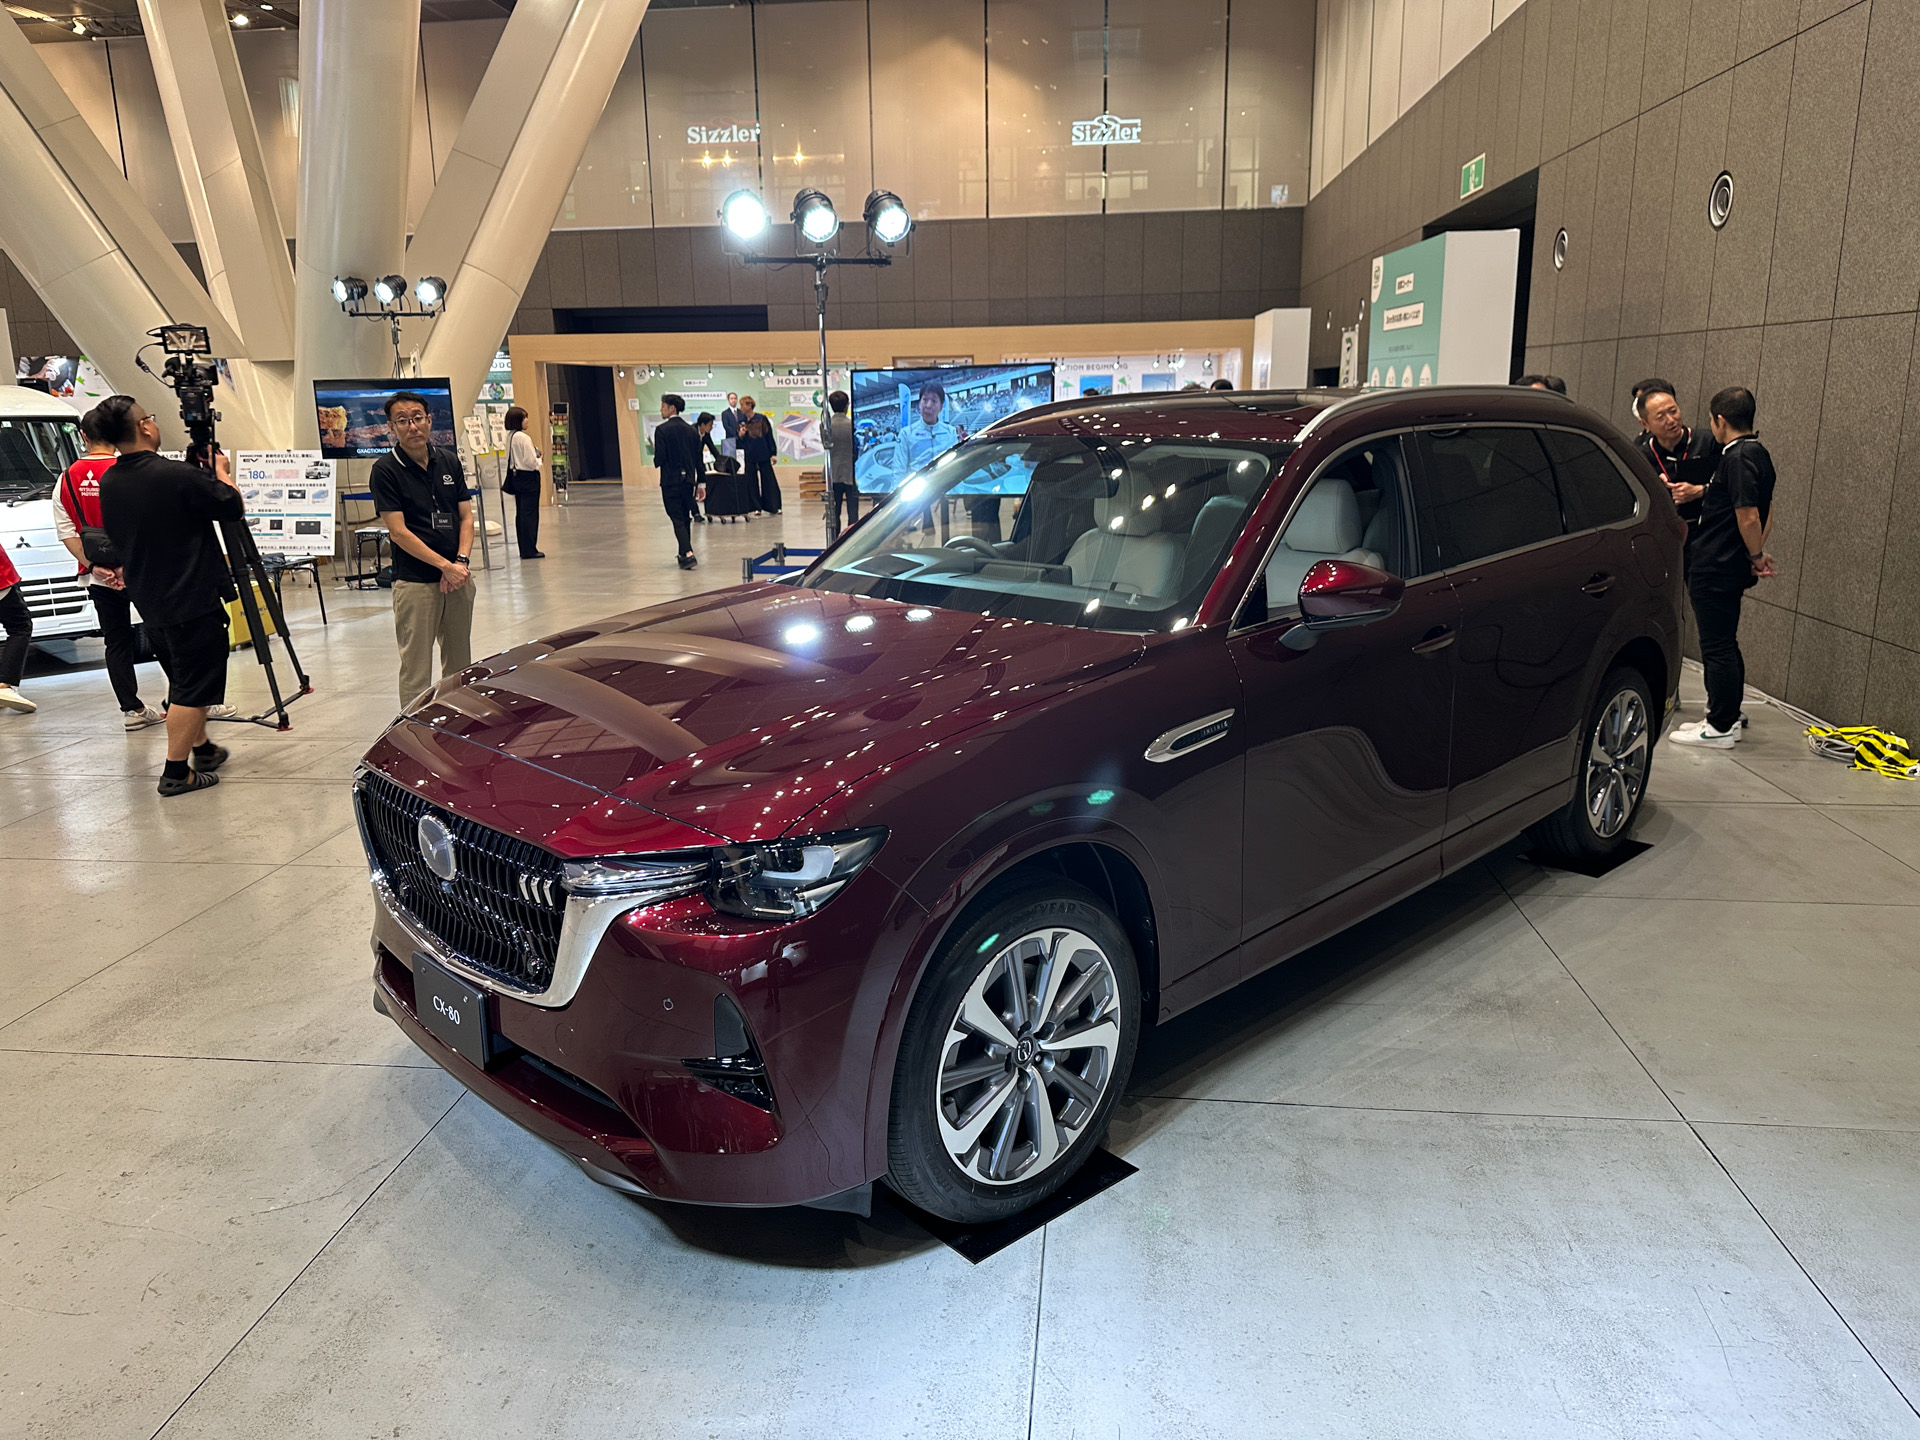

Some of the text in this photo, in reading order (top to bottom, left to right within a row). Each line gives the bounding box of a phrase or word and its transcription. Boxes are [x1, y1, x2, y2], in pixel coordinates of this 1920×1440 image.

[687, 124, 760, 144] Sizzler
[1072, 124, 1142, 142] Sizzler
[1086, 363, 1128, 371] BEGINNNG
[777, 377, 812, 385] HOUSE
[248, 470, 266, 479] 180
[433, 995, 460, 1025] CX-80
